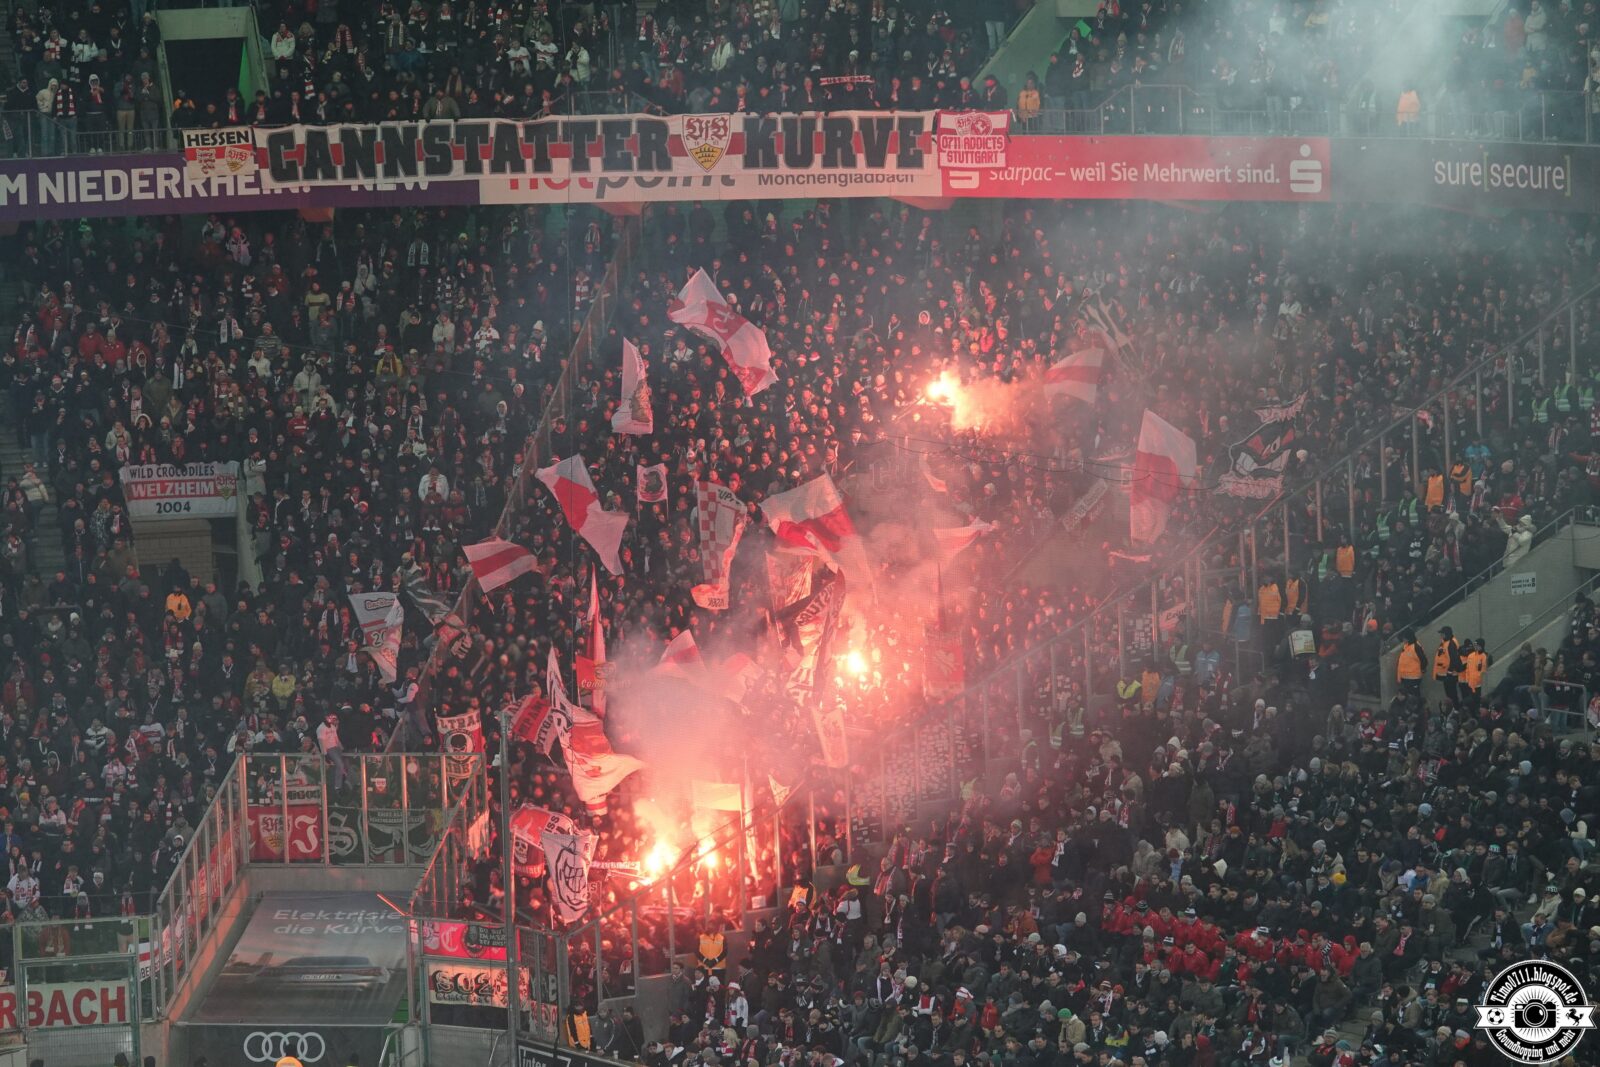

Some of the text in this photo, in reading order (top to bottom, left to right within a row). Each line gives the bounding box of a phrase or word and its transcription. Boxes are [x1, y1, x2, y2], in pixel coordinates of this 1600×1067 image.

[186, 130, 250, 147] HESSEN
[941, 136, 1004, 151] 0711 ADDICTS
[267, 116, 926, 183] CANNSTATTER KURVE
[947, 150, 998, 164] STUTTGART
[1070, 163, 1105, 181] weil
[1111, 162, 1137, 182] Sie
[1143, 163, 1231, 184] Mehrwert
[1237, 164, 1281, 184] sind.
[130, 468, 153, 479] WILD
[131, 480, 215, 498] WELZHEIM
[156, 501, 191, 513] 2004
[273, 924, 404, 934] die Kurve
